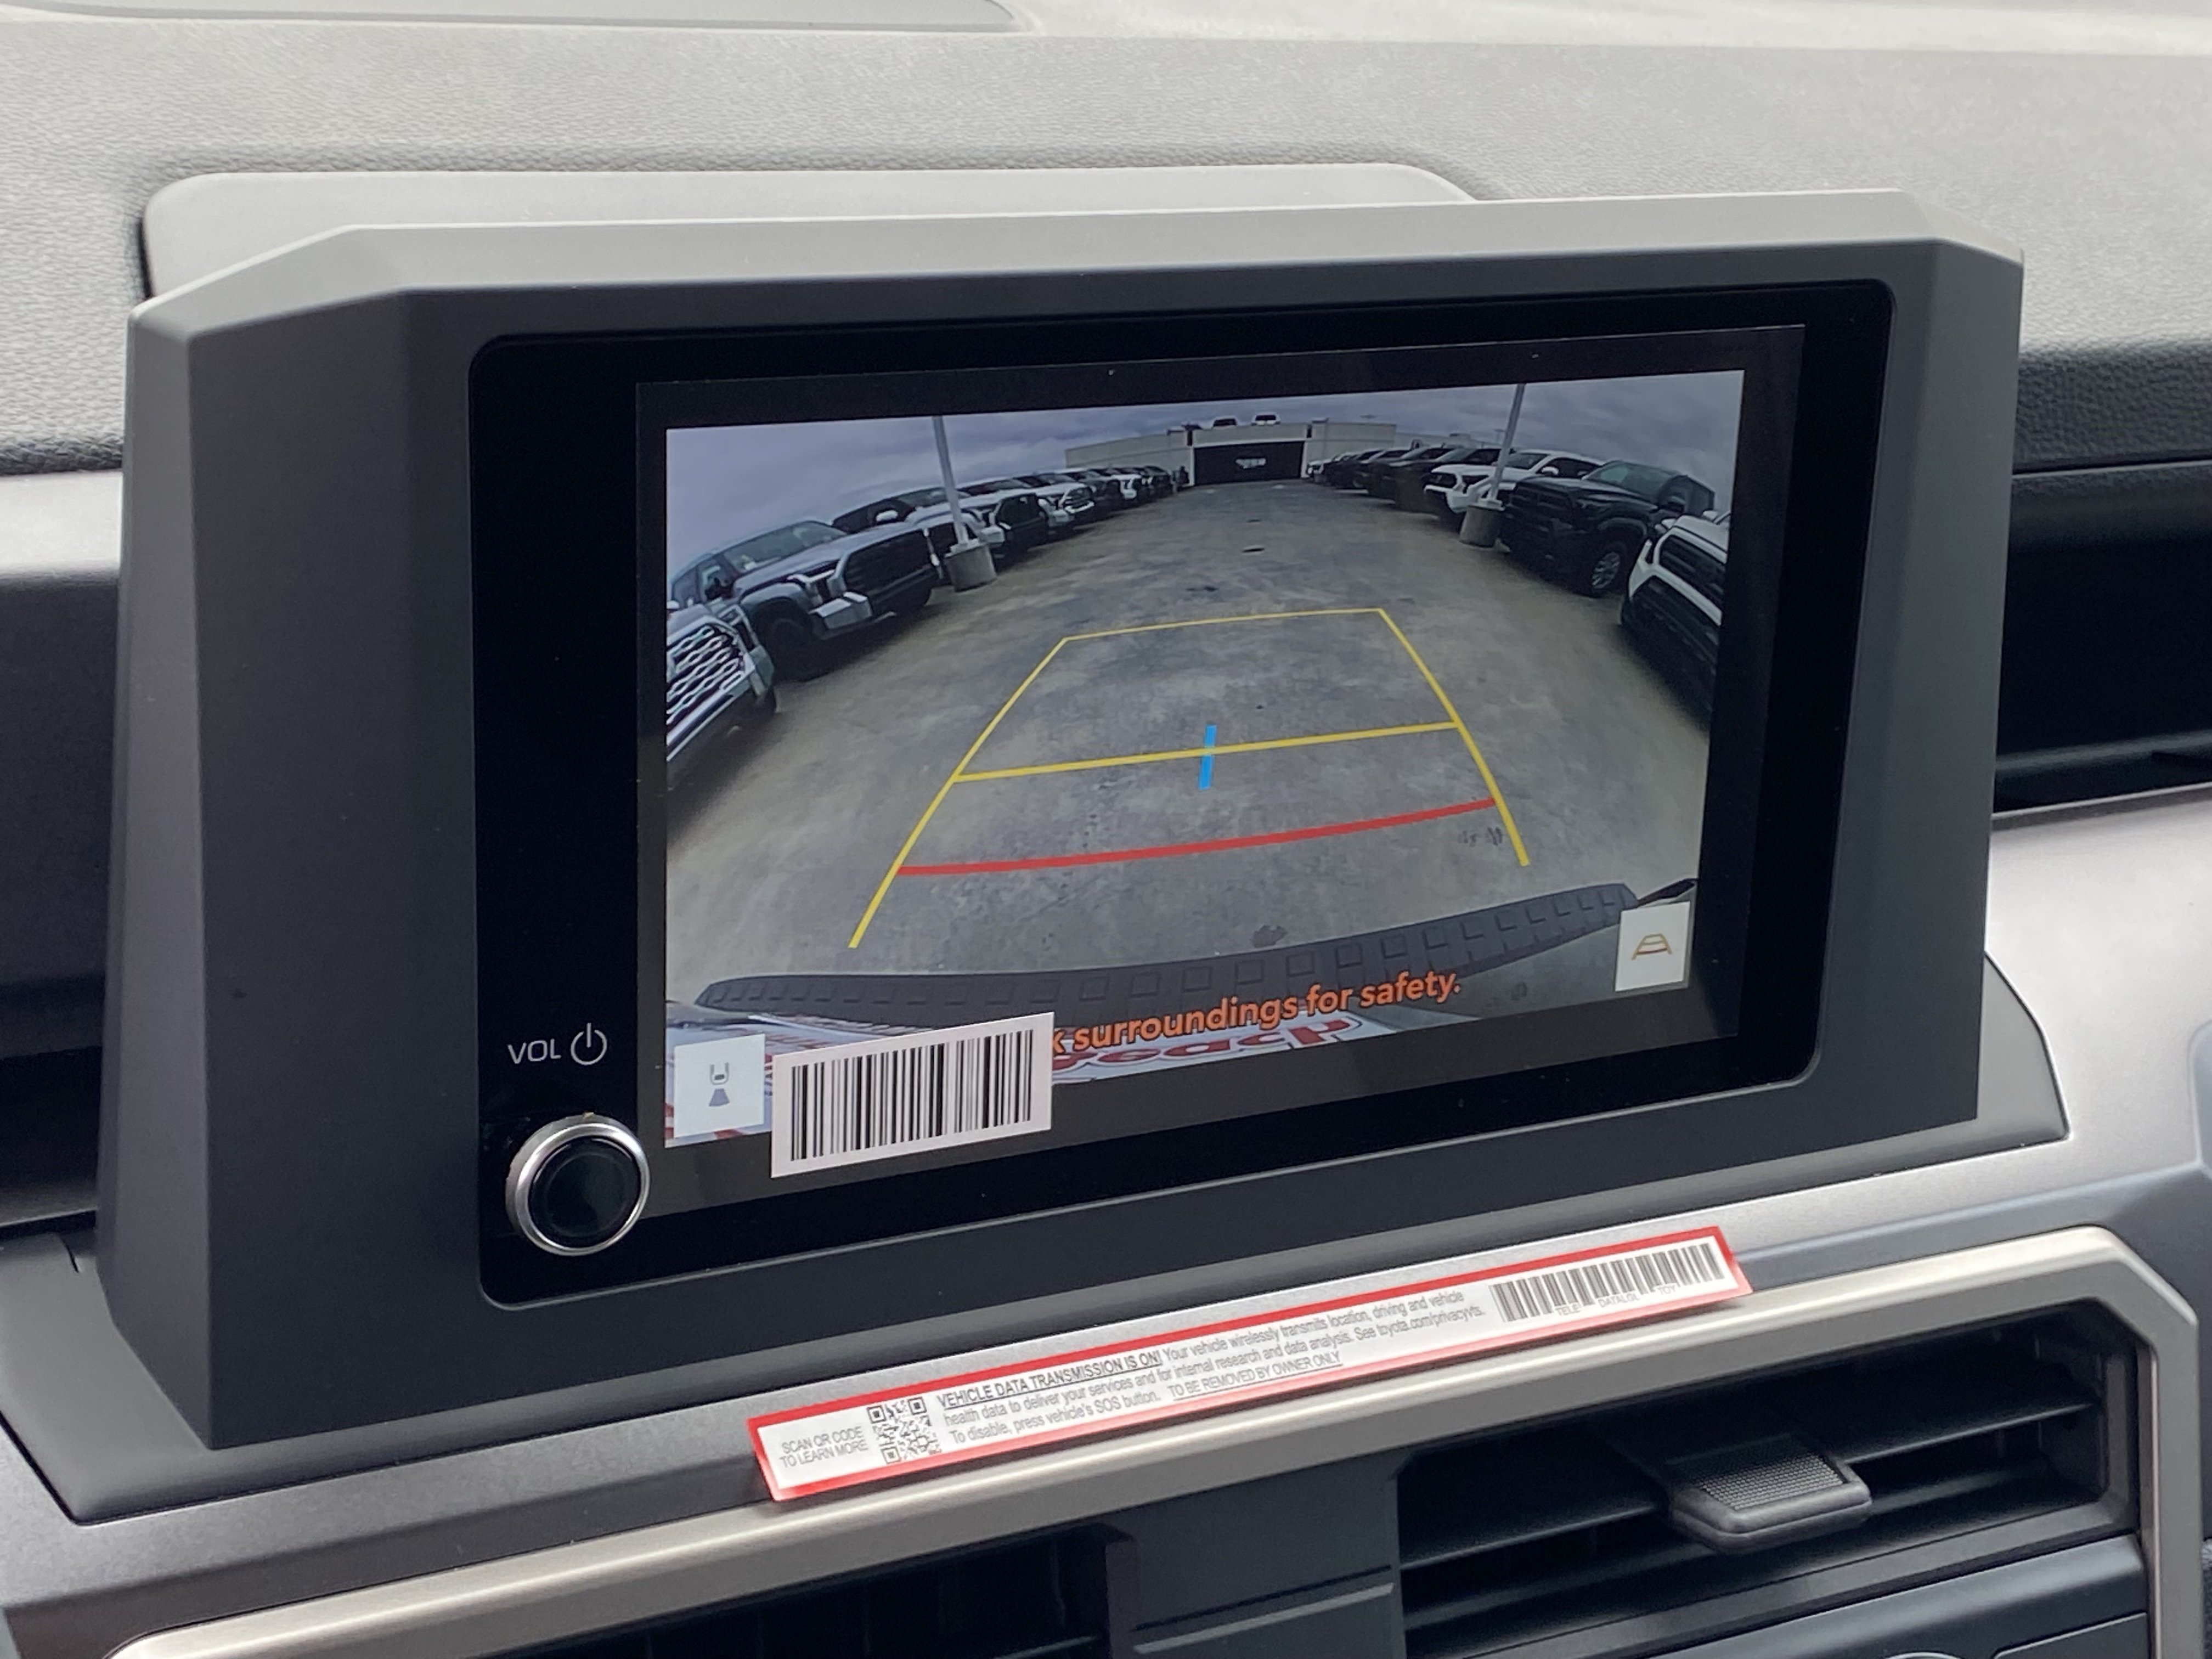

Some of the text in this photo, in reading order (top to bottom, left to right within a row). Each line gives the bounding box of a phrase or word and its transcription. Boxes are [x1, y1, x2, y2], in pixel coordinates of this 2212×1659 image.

[507, 1039, 561, 1064] VOL
[1072, 995, 1298, 1052] surroundings
[1306, 983, 1353, 1016] for
[1359, 970, 1462, 1007] safety.
[936, 1290, 1465, 1408] VEHICLE DATA TRANSMISSION IS ON! Your vehicle wirelessly transmits location, driving and vehicle
[943, 1408, 980, 1426] health
[981, 1402, 1008, 1420] data
[1008, 1400, 1022, 1413] to
[1023, 1393, 1060, 1410] deliver
[1060, 1387, 1087, 1406] your
[1088, 1378, 1133, 1397] services
[1135, 1371, 1156, 1386] and
[1156, 1367, 1172, 1382] for
[1175, 1358, 1215, 1378] internal
[1215, 1348, 1262, 1369] research
[1263, 1345, 1284, 1360] and
[1284, 1339, 1308, 1355] data
[1308, 1332, 1354, 1350] analysis.
[1354, 1326, 1377, 1340] See
[949, 1350, 1341, 1444] To disable, press vehicle's SOS button. TO BE REMOVED BY OWNER ONLY
[779, 1438, 869, 1469] TO LEARN MORE
[781, 1426, 865, 1454] SCAN QR CODE
